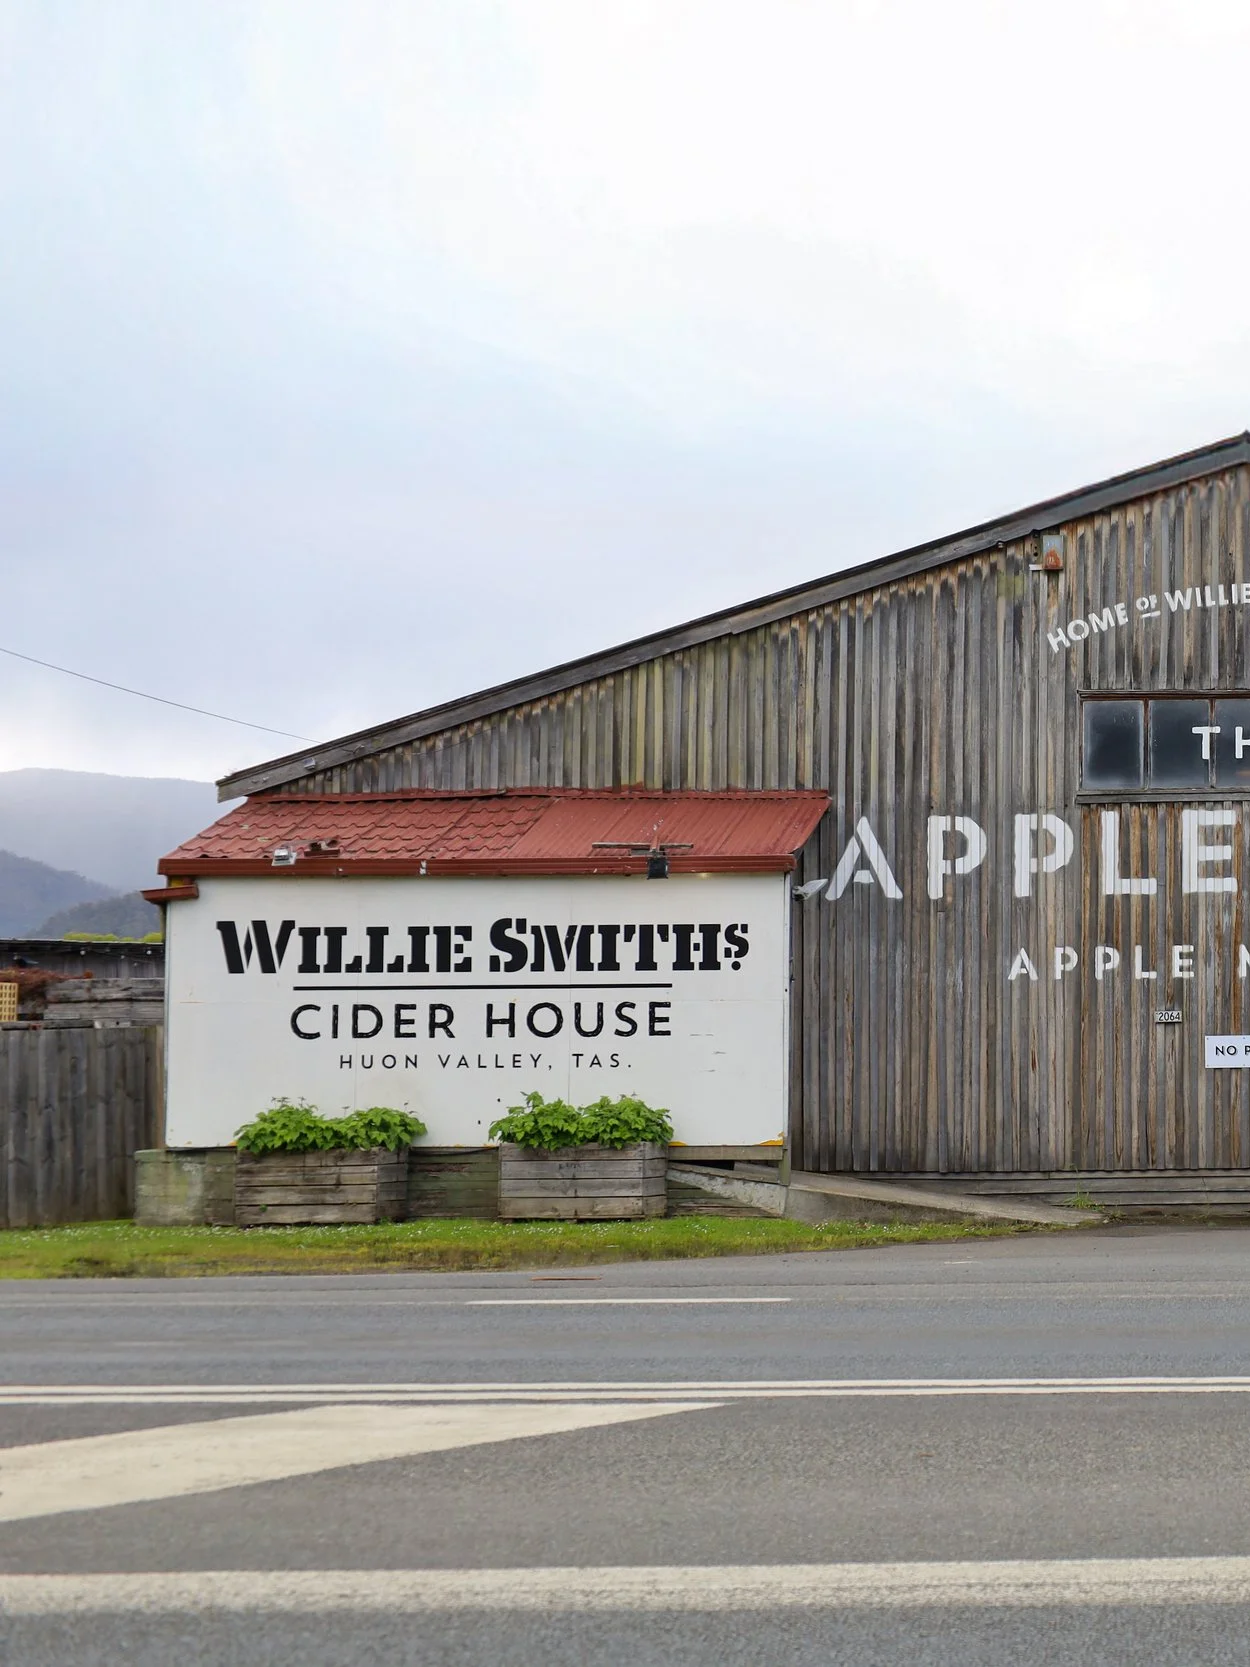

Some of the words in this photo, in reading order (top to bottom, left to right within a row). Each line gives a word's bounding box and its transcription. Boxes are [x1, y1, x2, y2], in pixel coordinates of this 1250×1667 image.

[1047, 602, 1129, 653] HOME
[1136, 594, 1160, 615] OF
[825, 809, 1239, 900] APPLE
[216, 920, 473, 974] WILLIE
[1008, 944, 1195, 981] APPLE
[290, 1003, 456, 1040] CIDER
[486, 1001, 672, 1038] HOUSE
[1158, 1011, 1181, 1022] 2064
[340, 1054, 418, 1069] HUON
[438, 1054, 552, 1071] VALLEY,
[572, 1053, 632, 1069] TAS.
[1215, 1045, 1238, 1056] NO
